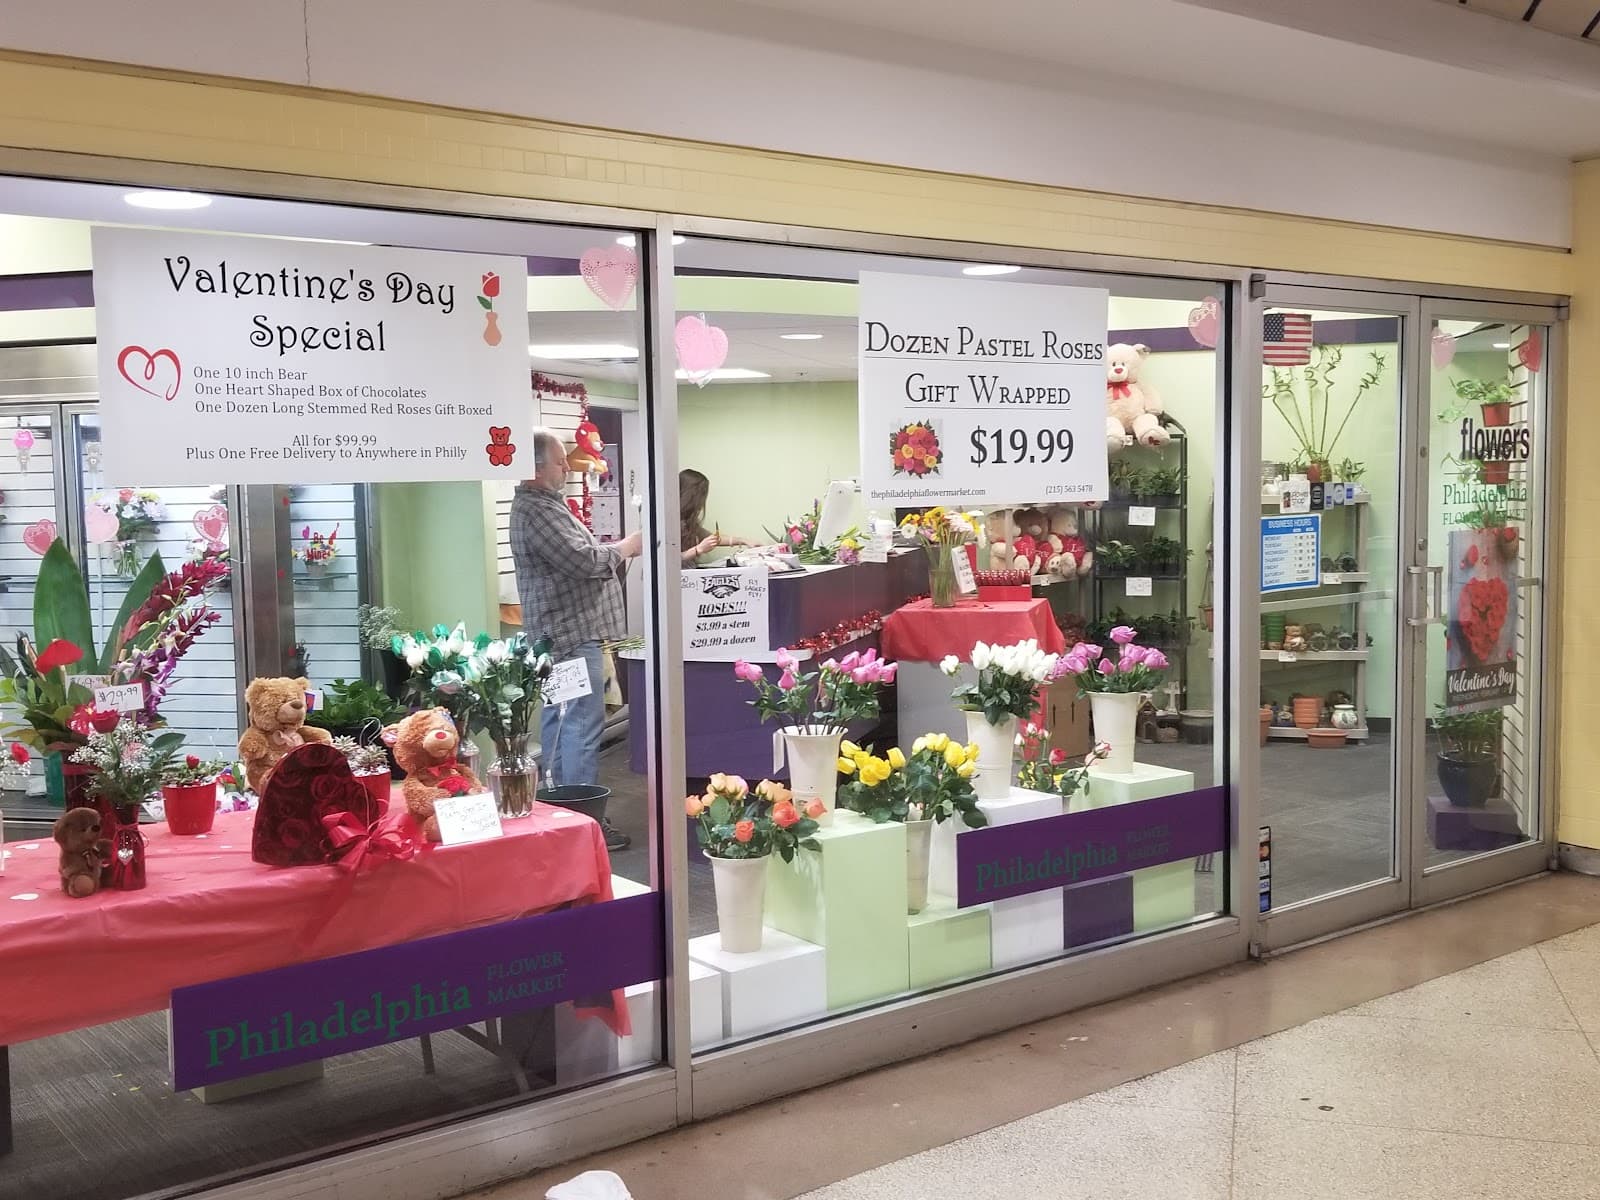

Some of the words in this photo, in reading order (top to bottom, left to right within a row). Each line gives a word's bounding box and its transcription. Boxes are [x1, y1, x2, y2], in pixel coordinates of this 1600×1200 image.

[164, 256, 375, 303] Valentine's
[387, 272, 456, 314] Day
[250, 314, 386, 356] Special
[193, 367, 220, 380] One
[225, 367, 242, 380] 10
[245, 367, 274, 381] inch
[278, 368, 308, 381] Bear
[195, 383, 222, 396] One
[225, 384, 264, 397] Heart
[267, 384, 315, 401] Shaped
[319, 385, 343, 398] Box
[346, 385, 359, 398] of
[361, 385, 427, 399] Chocolates
[195, 401, 222, 414] One
[226, 401, 269, 415] Dozen
[272, 401, 304, 417] Long
[307, 401, 367, 416] Stemmed
[371, 402, 394, 415] Red
[397, 403, 432, 416] Roses
[434, 402, 456, 416] Gift
[458, 402, 493, 416] Boxed
[292, 434, 310, 447] All
[312, 433, 332, 447] for
[334, 432, 377, 448] $99.99
[970, 425, 1074, 468] $19.99
[1461, 418, 1530, 460] flowers
[186, 446, 215, 460] Plus
[218, 446, 247, 460] One
[250, 446, 279, 460] Free
[282, 446, 337, 462] Delivery
[339, 447, 353, 459] to
[355, 446, 418, 462] Anywhere
[420, 446, 432, 458] in
[434, 446, 467, 461] Philly
[871, 486, 986, 500] thephiladelphiaflowermarket.com
[1045, 484, 1064, 495] (215)
[698, 601, 747, 615] ROSES!!!
[696, 620, 721, 632] $3.99
[722, 622, 728, 630] a
[729, 620, 750, 629] stem
[690, 637, 722, 649] $29.99
[723, 638, 729, 646] a
[730, 635, 756, 645] dozen
[1498, 666, 1515, 694] Day
[97, 686, 138, 706] $29.99
[976, 841, 1118, 893] Philadelphia
[486, 973, 568, 1006] MARKET
[206, 980, 472, 1069] Philadelphia
[486, 951, 564, 982] FLOWER
